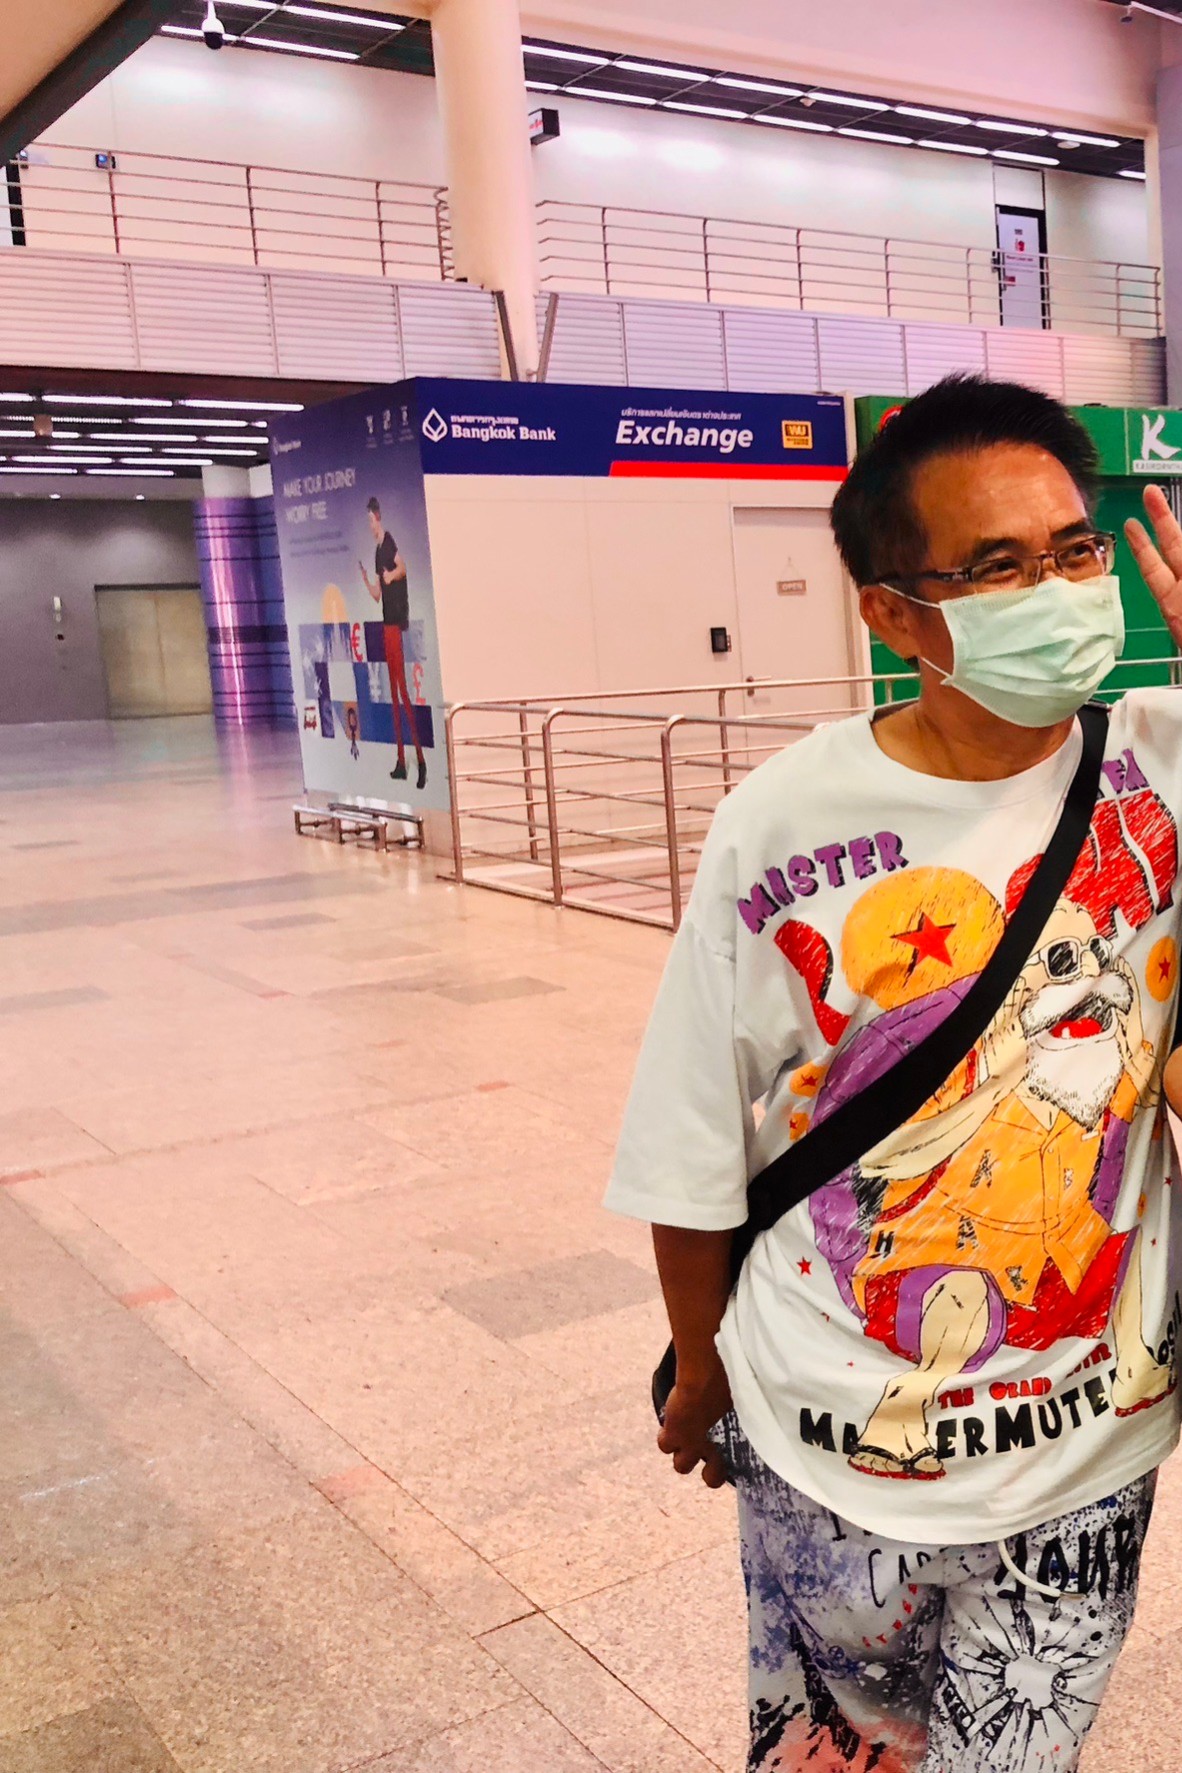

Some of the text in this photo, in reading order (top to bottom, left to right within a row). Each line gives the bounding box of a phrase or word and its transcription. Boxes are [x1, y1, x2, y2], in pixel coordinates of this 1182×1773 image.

[451, 424, 556, 442] Bangkok Bank
[615, 419, 754, 454] Exchange
[737, 831, 909, 934] MISTER
[938, 1387, 974, 1409] THE
